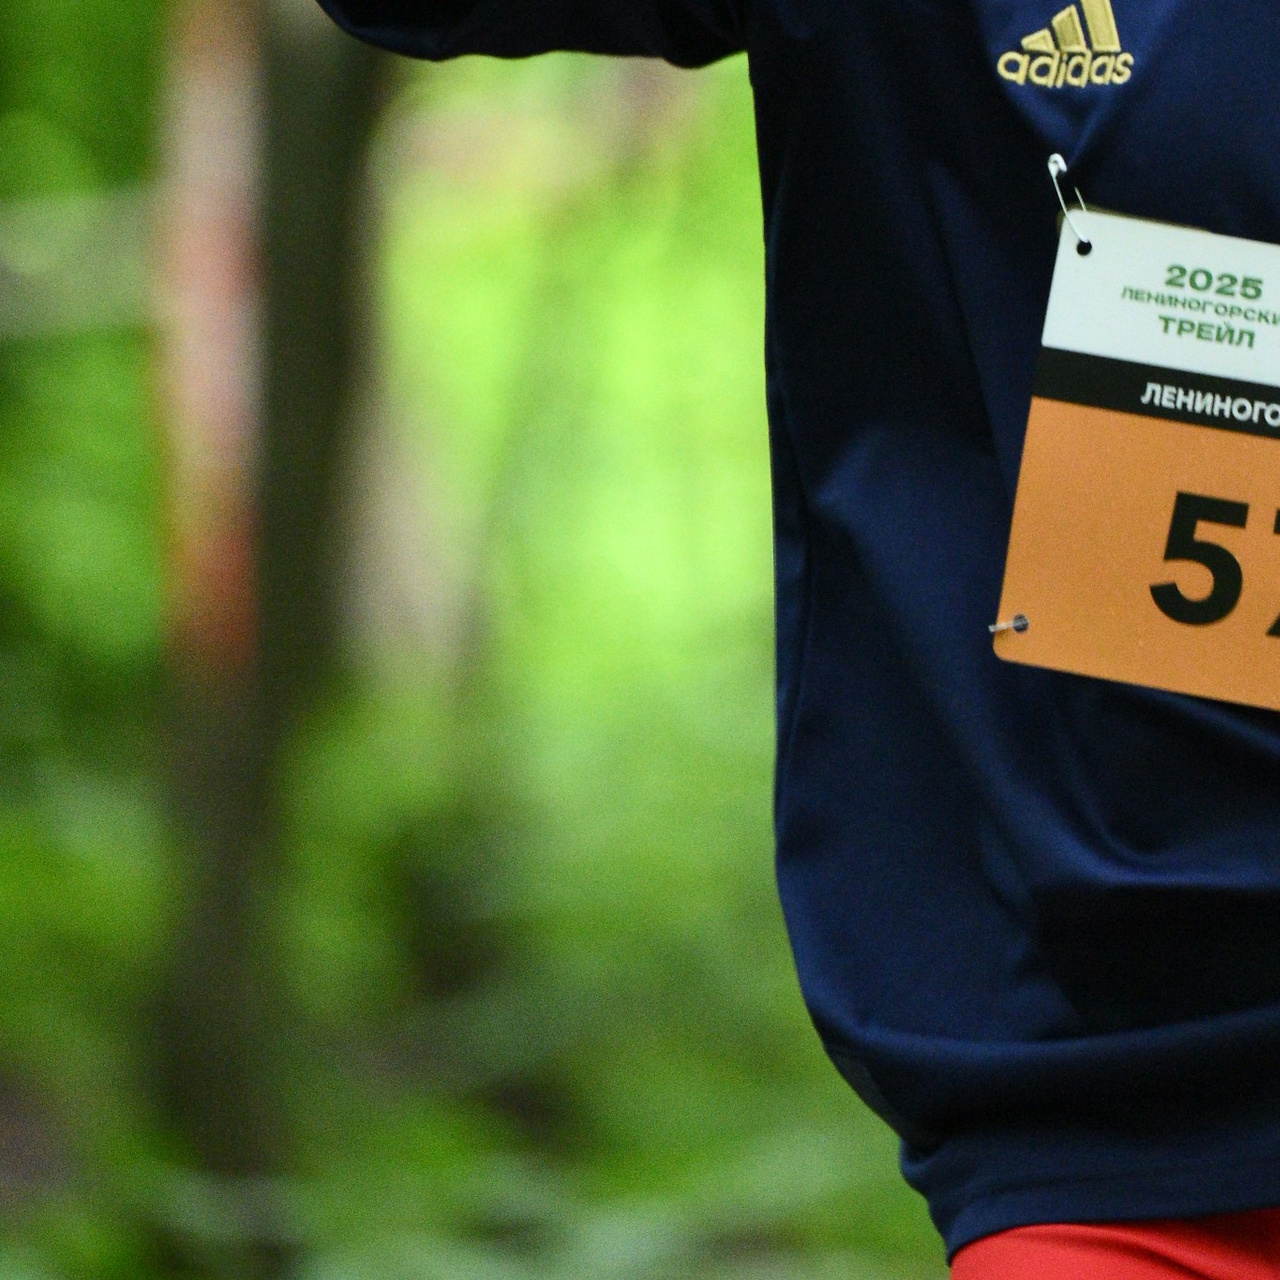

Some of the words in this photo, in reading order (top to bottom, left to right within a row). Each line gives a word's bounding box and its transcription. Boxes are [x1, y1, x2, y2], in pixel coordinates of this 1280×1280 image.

[997, 50, 1135, 89] adidas
[1164, 263, 1264, 301] 2025
[1157, 314, 1256, 349] ТРЕЙЛ
